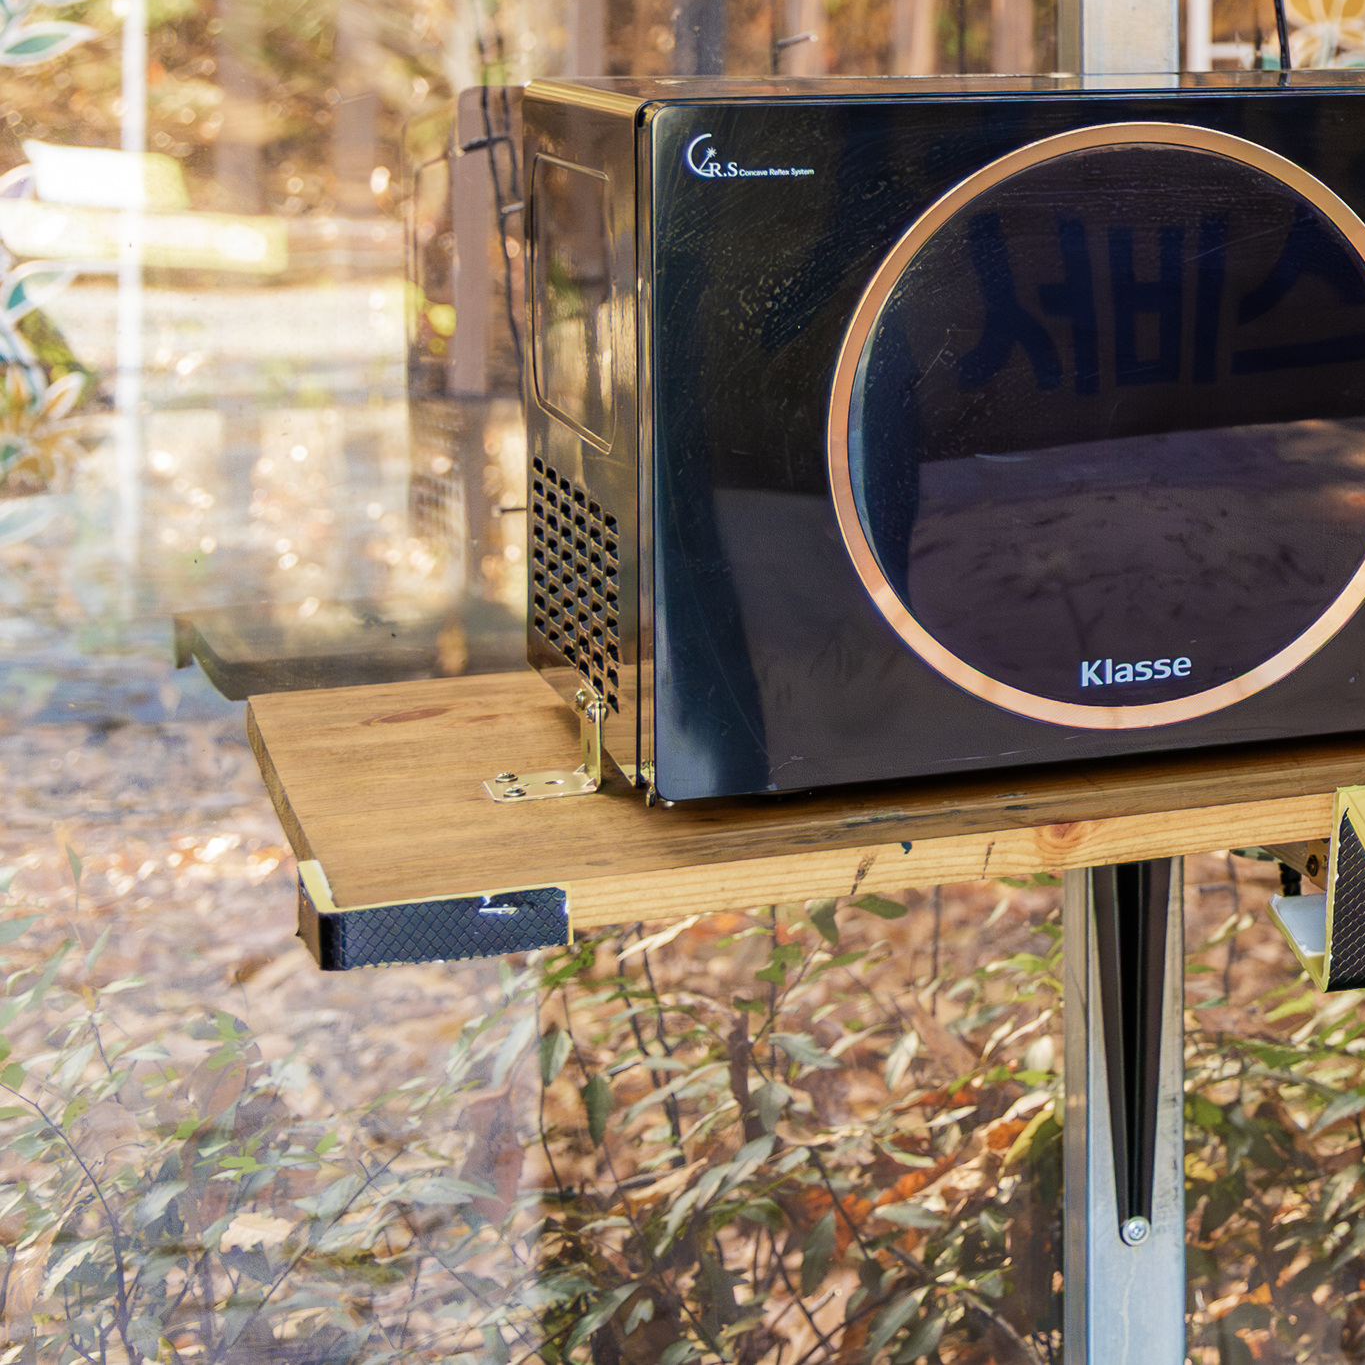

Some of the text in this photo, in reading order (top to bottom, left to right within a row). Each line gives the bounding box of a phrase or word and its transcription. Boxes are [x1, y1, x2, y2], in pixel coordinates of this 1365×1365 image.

[739, 168, 768, 177] Concave
[769, 168, 790, 176] Reflex
[791, 167, 815, 176] System
[1080, 656, 1193, 687] Klasse
